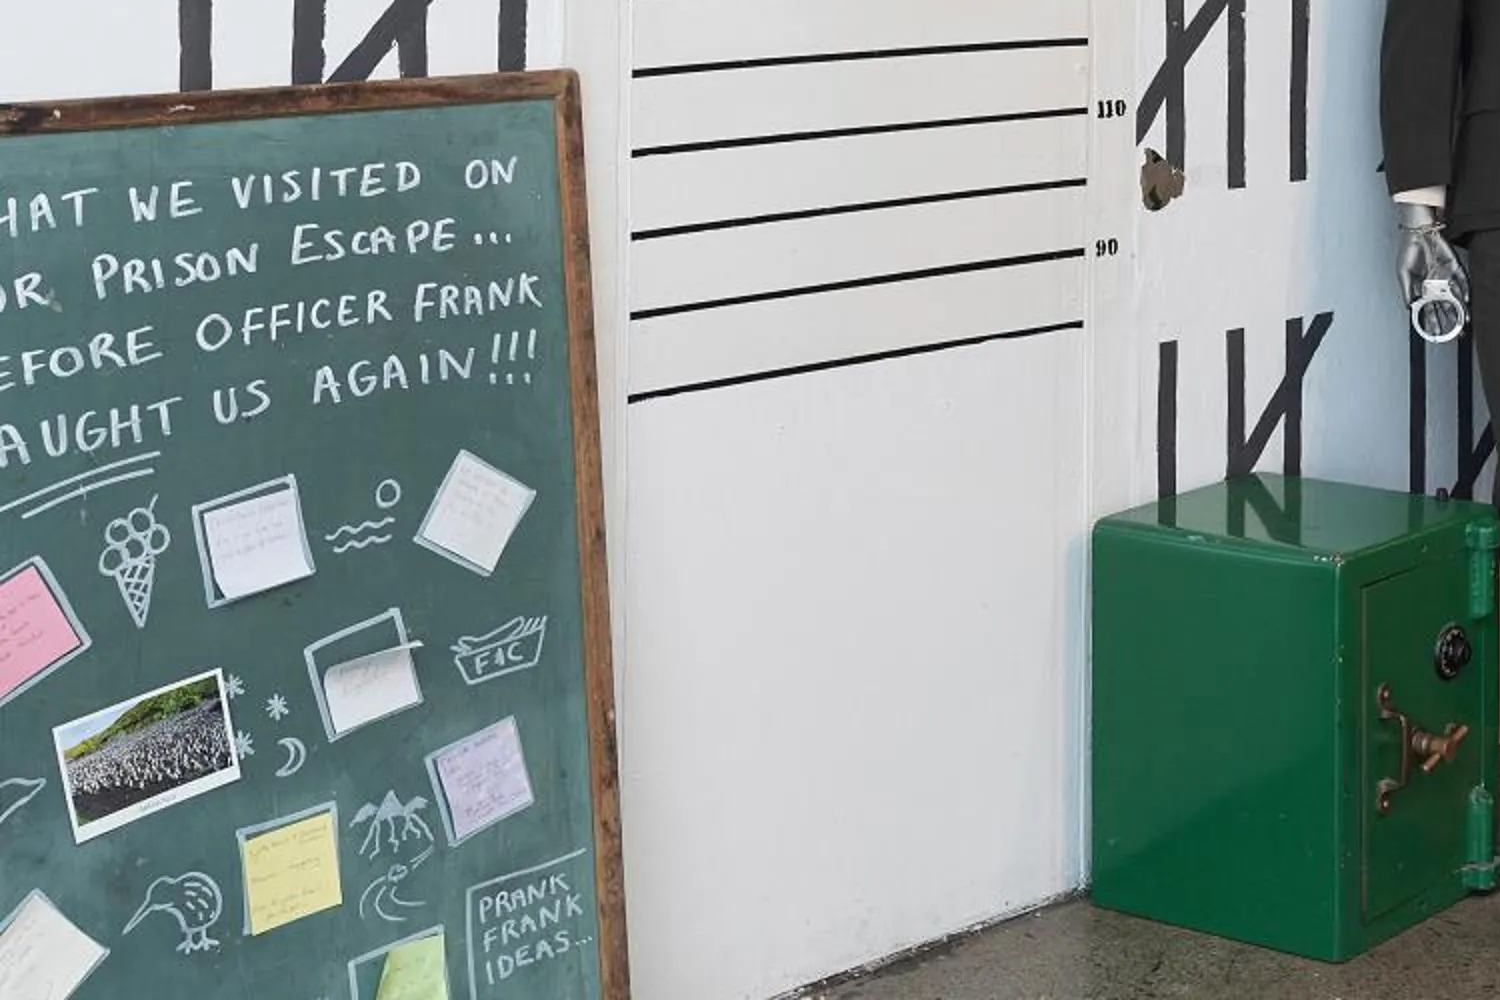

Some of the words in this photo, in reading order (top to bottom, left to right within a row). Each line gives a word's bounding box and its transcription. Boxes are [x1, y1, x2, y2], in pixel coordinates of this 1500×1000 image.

[1097, 100, 1126, 118] 110
[129, 181, 203, 222] WE
[232, 161, 421, 209] VISITED
[464, 156, 518, 190] ON
[92, 243, 259, 300] PRISON
[1096, 238, 1118, 257] 90
[197, 289, 393, 352] OFFICER
[414, 272, 544, 323] FRANK
[0, 396, 183, 469] AUGHT
[212, 379, 272, 425] US
[313, 328, 538, 405] AGAIN!!!
[479, 873, 571, 924] PRANK
[483, 893, 584, 952] FRANK
